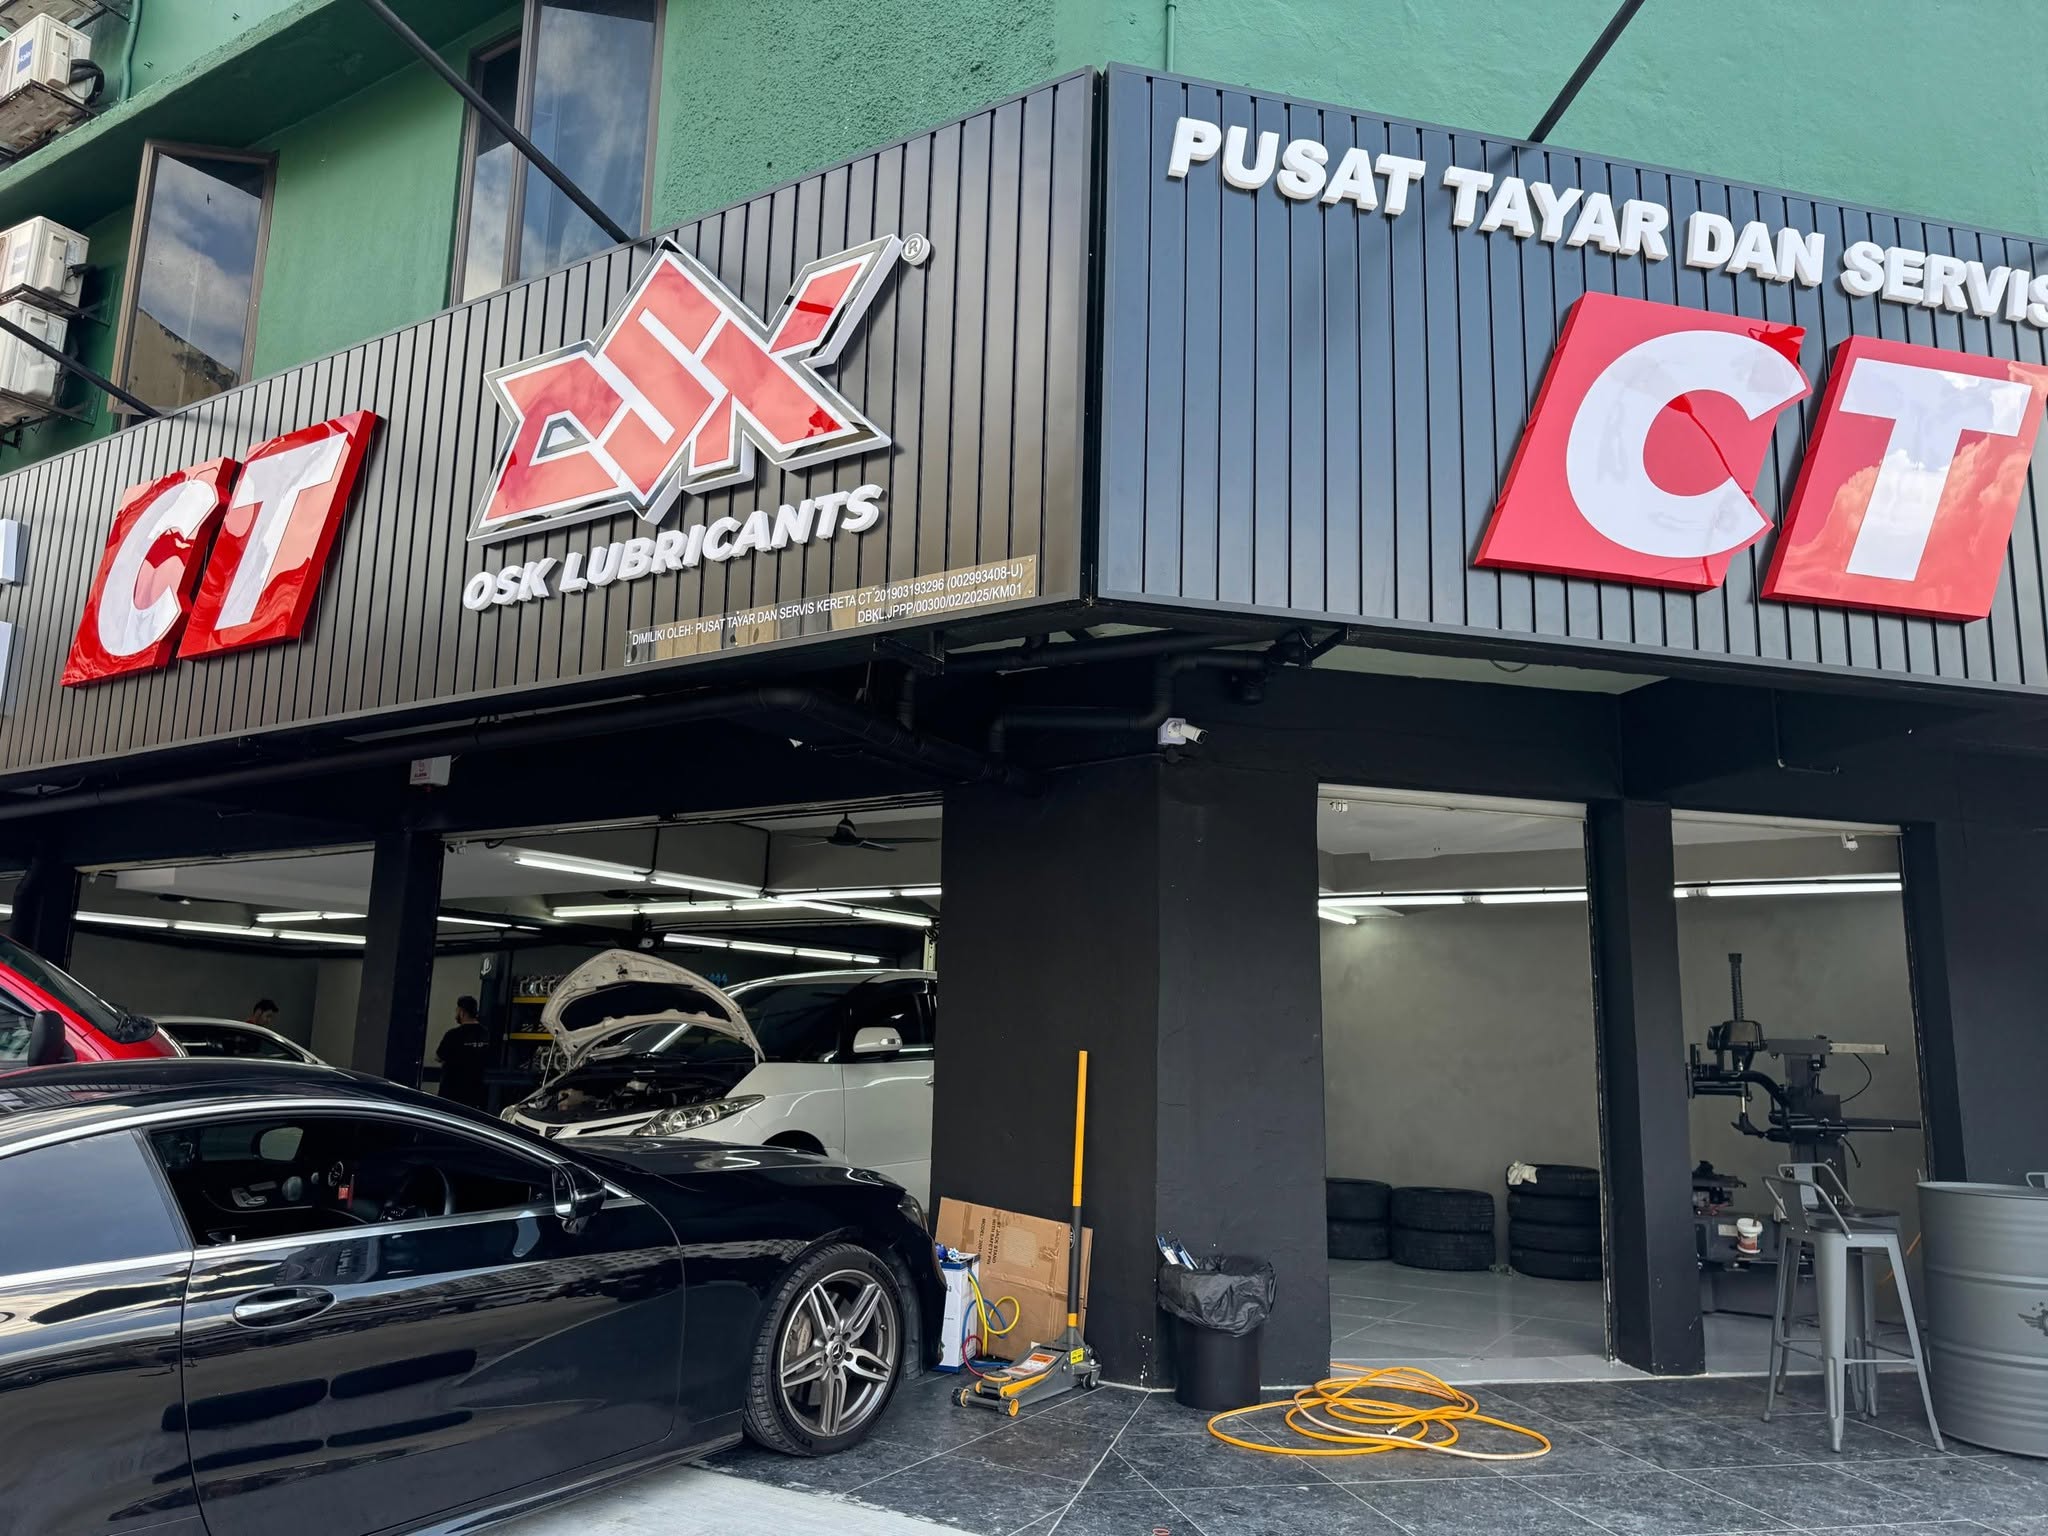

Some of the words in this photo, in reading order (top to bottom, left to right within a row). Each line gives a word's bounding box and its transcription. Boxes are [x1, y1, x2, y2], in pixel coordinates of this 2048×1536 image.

[1167, 116, 1427, 216] PUSAT
[1443, 165, 1669, 261] TAYAR
[1686, 211, 1825, 287] DAN
[1565, 330, 2035, 582] CT
[98, 431, 350, 658] CT
[463, 557, 558, 611] OSK
[559, 484, 884, 594] LUBRICANTS
[632, 631, 665, 645] DIMILIKI
[667, 625, 694, 639] OLEH:
[696, 619, 725, 634] PUSAT
[727, 614, 756, 629] TAYAR
[758, 609, 777, 623] DAN
[780, 602, 815, 619] SERVIS
[817, 595, 856, 612] KERETA
[859, 592, 873, 605] CT
[874, 579, 945, 602] 201903193296
[947, 563, 1023, 592] (002993408-U)
